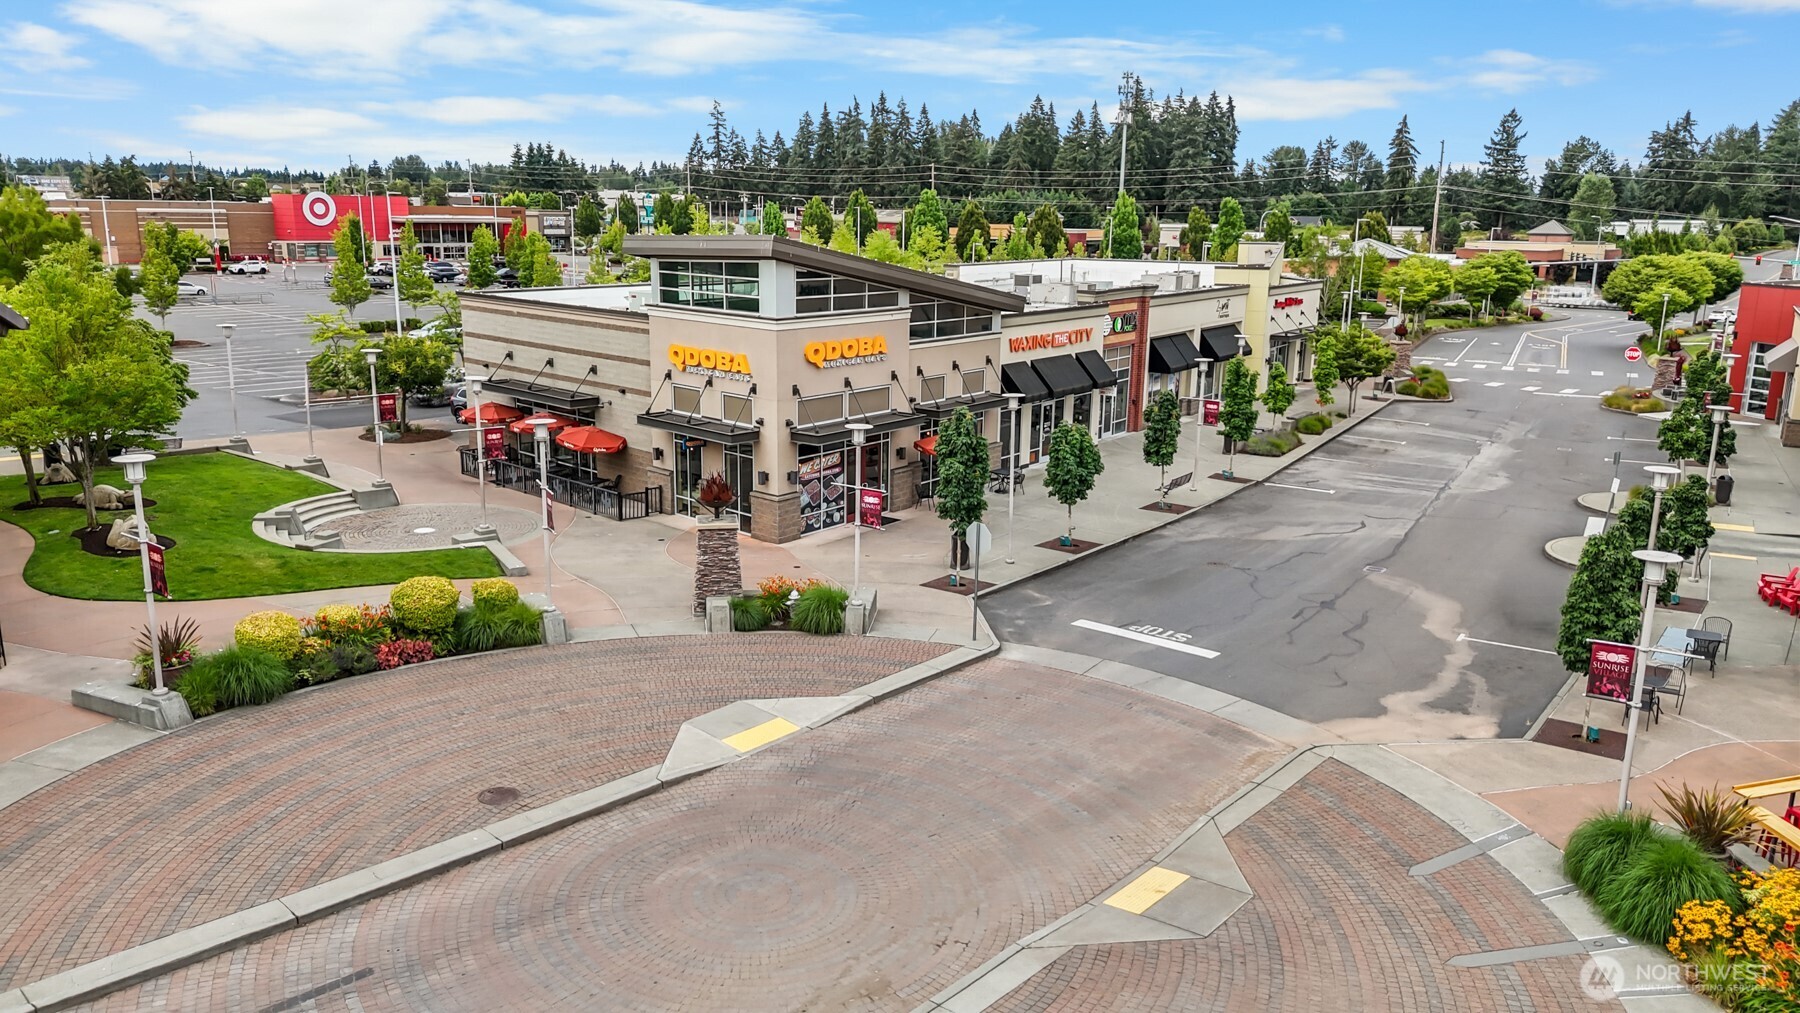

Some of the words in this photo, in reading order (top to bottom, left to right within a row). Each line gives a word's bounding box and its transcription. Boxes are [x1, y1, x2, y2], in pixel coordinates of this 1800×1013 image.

[1009, 333, 1051, 353] WAXING
[1055, 333, 1069, 344] THE
[1068, 328, 1093, 345] CITY
[668, 344, 751, 372] QDOBA
[804, 335, 888, 369] QDOBA
[800, 461, 813, 474] WE
[1129, 624, 1192, 642] STOP
[1592, 660, 1630, 673] SUNRISE
[1594, 668, 1627, 680] VILLAGE
